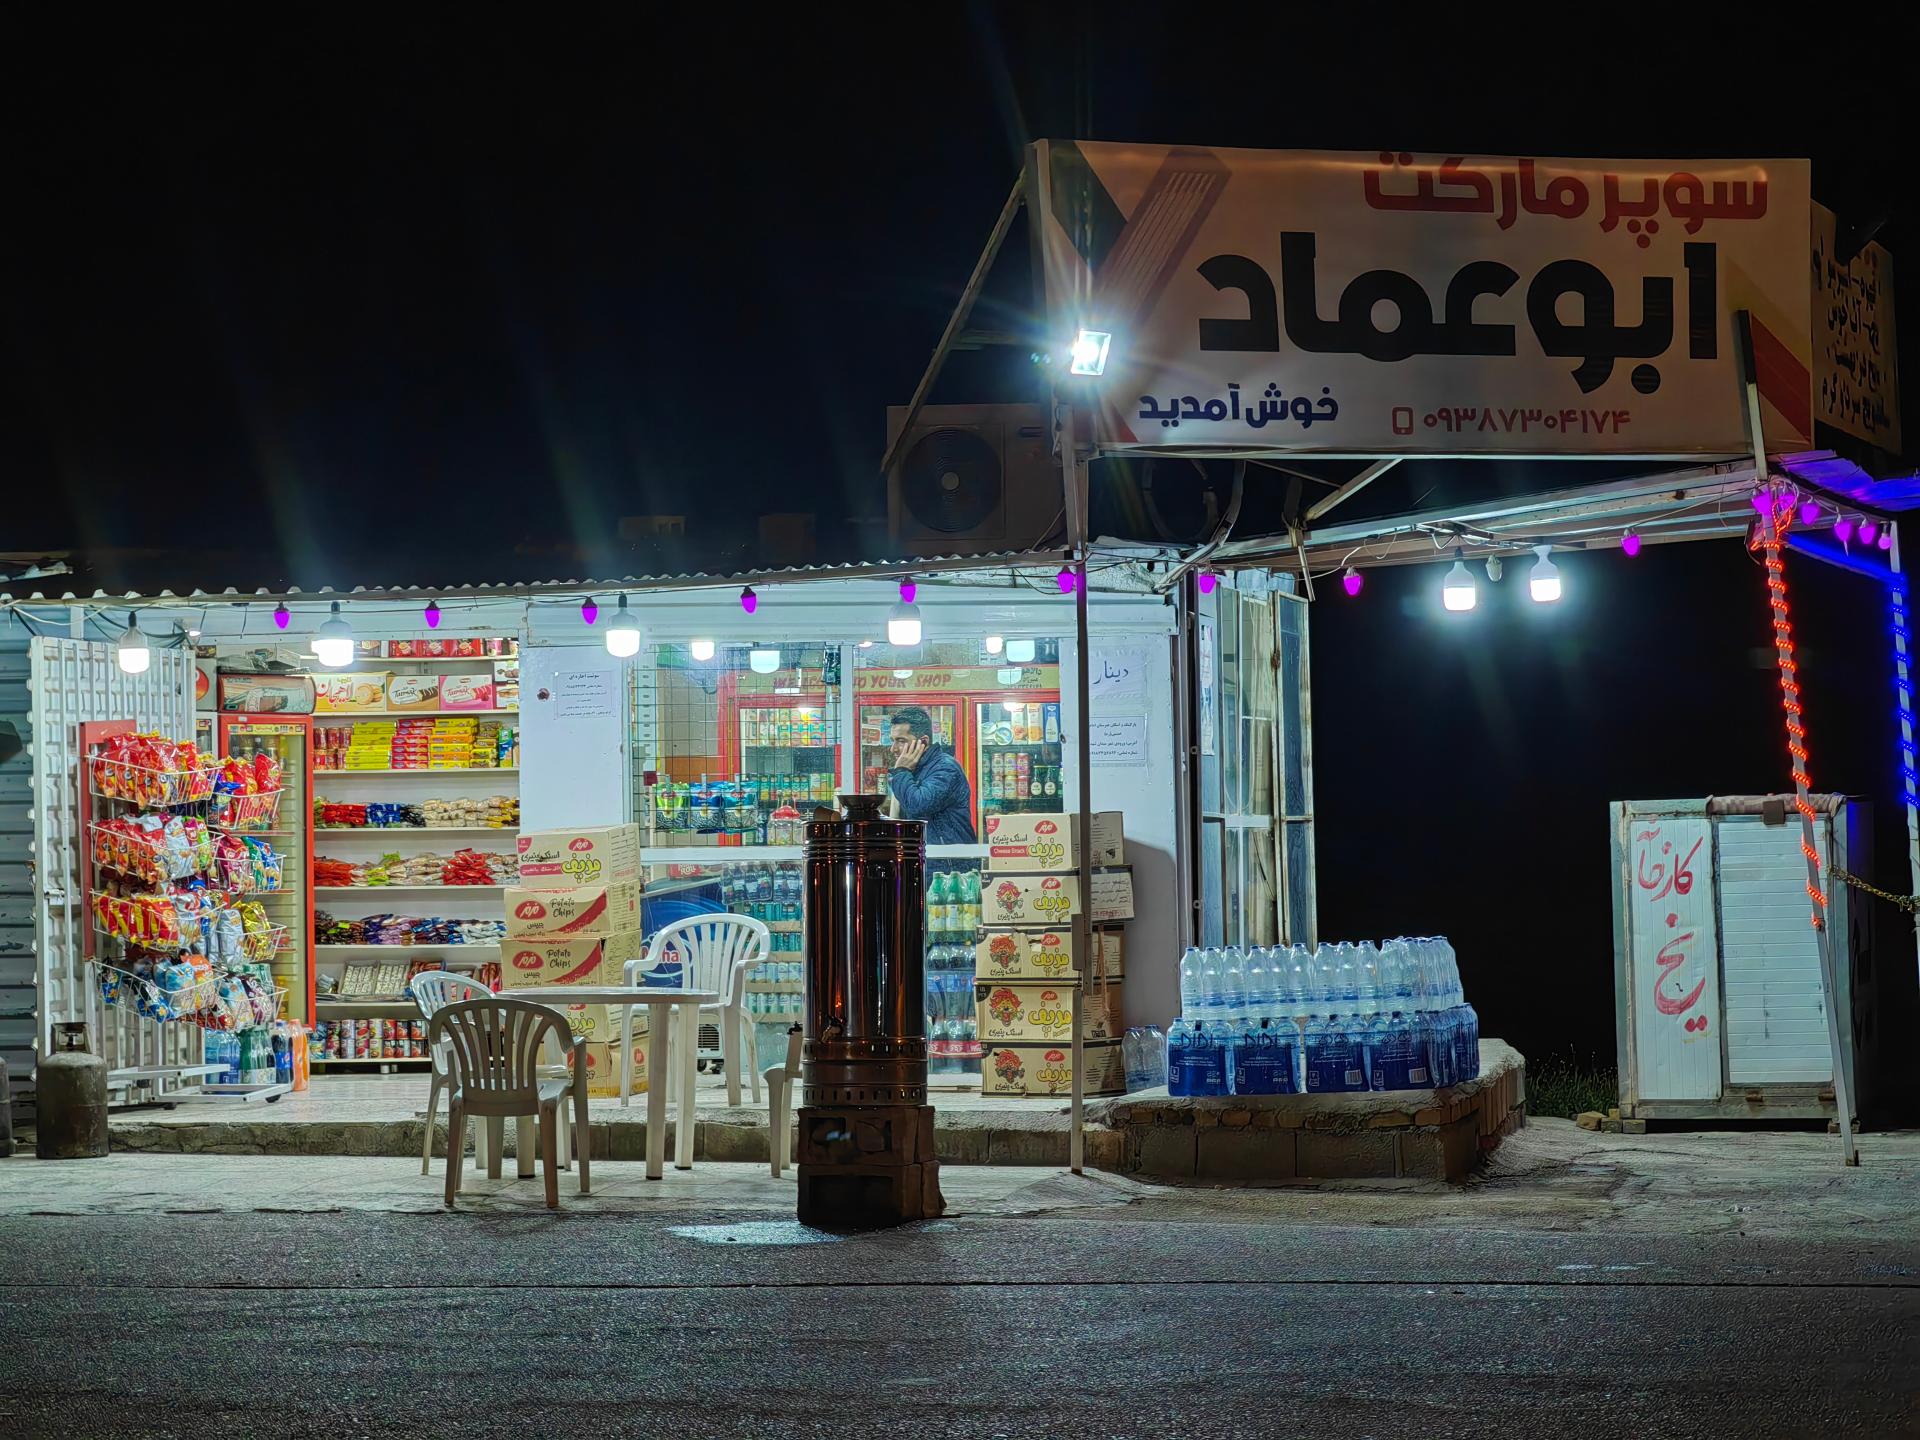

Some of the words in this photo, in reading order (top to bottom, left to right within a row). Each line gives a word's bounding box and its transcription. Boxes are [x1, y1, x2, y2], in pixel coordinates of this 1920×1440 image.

[1363, 152, 1590, 230] مارکت
[1599, 171, 1768, 248] سوپر
[1138, 382, 1241, 428] آمدید
[1245, 382, 1339, 429] خوش
[1423, 406, 1631, 433] ۰۹۳۸۷۳۰۴۱۷۴
[914, 674, 952, 687] SHOP
[1091, 660, 1129, 684] دینار
[549, 897, 575, 908] Potato
[552, 907, 575, 919] Chips
[546, 948, 572, 959] Potato
[549, 958, 571, 969] Chips
